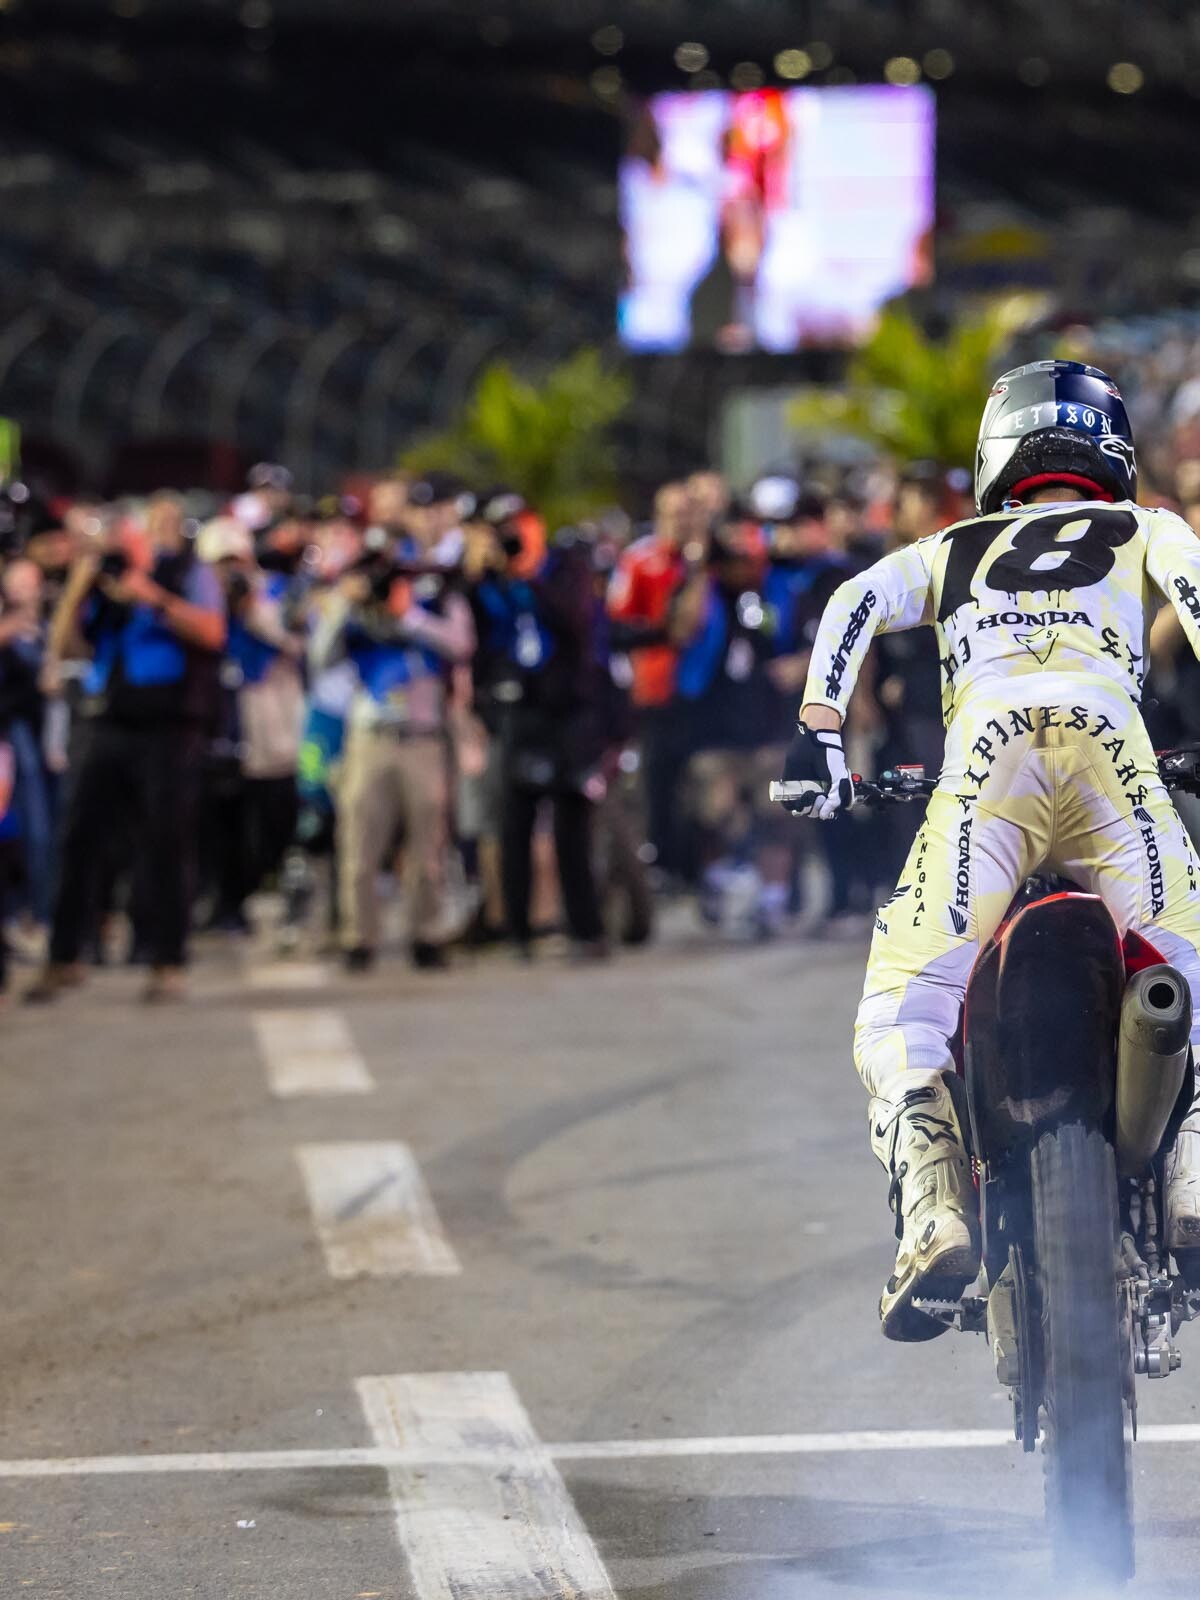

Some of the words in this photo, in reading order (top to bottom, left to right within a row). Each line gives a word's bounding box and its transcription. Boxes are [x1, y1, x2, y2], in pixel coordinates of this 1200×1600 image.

[1014, 404, 1113, 439] ETTSON
[937, 508, 1139, 626] 18
[825, 589, 877, 701] alpinestars
[976, 611, 1094, 632] HONDA
[955, 705, 1148, 815] ALPINESTARS
[956, 818, 973, 909] HONDA
[1140, 826, 1165, 919] HONDA
